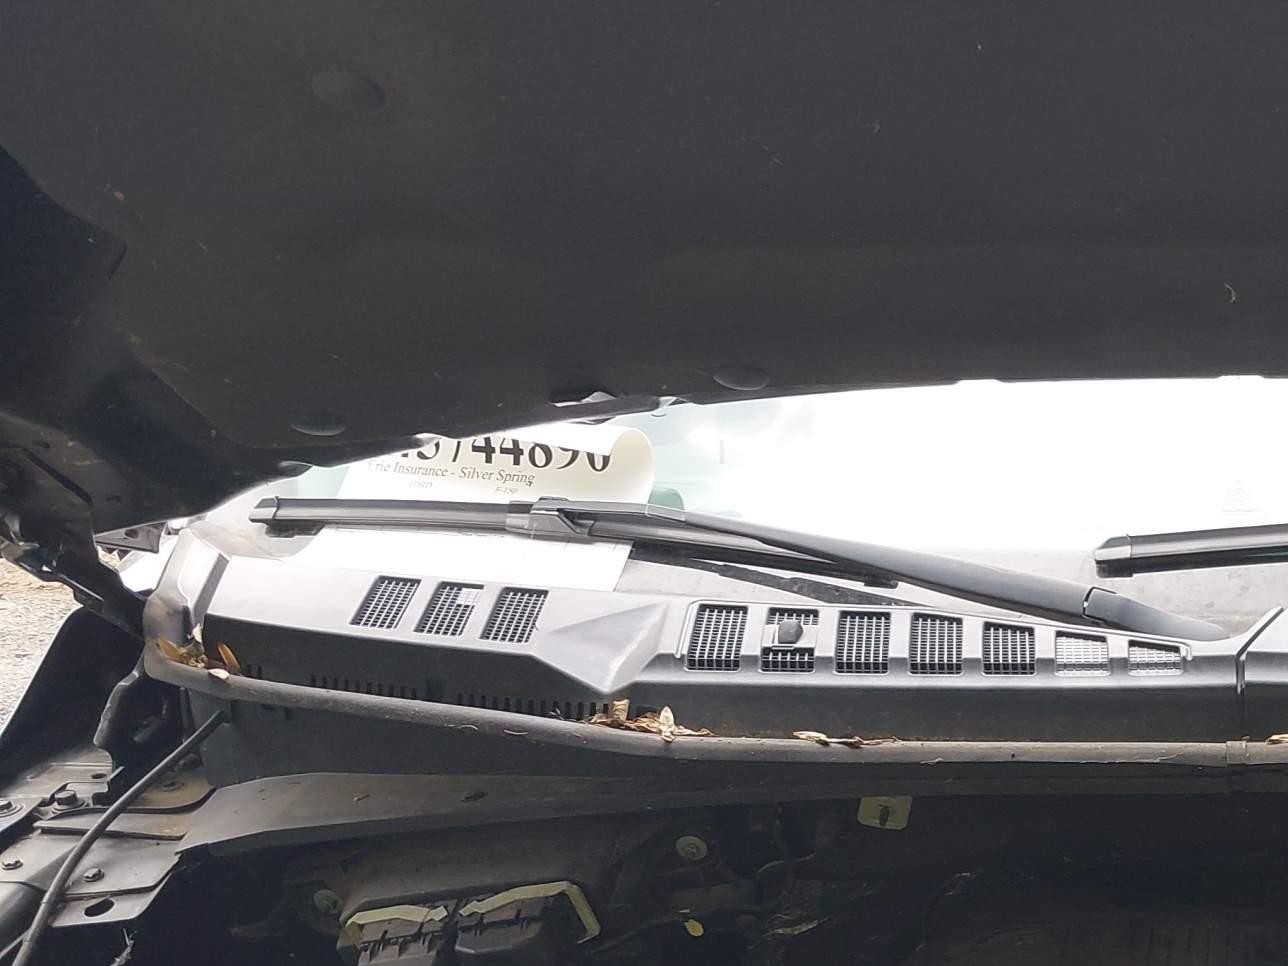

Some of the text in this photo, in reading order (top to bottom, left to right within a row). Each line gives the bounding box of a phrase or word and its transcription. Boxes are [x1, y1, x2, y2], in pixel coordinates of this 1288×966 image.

[398, 435, 612, 473] 74489
[393, 462, 449, 478] Insurance
[459, 466, 494, 481] Silver
[497, 468, 536, 487] Spring
